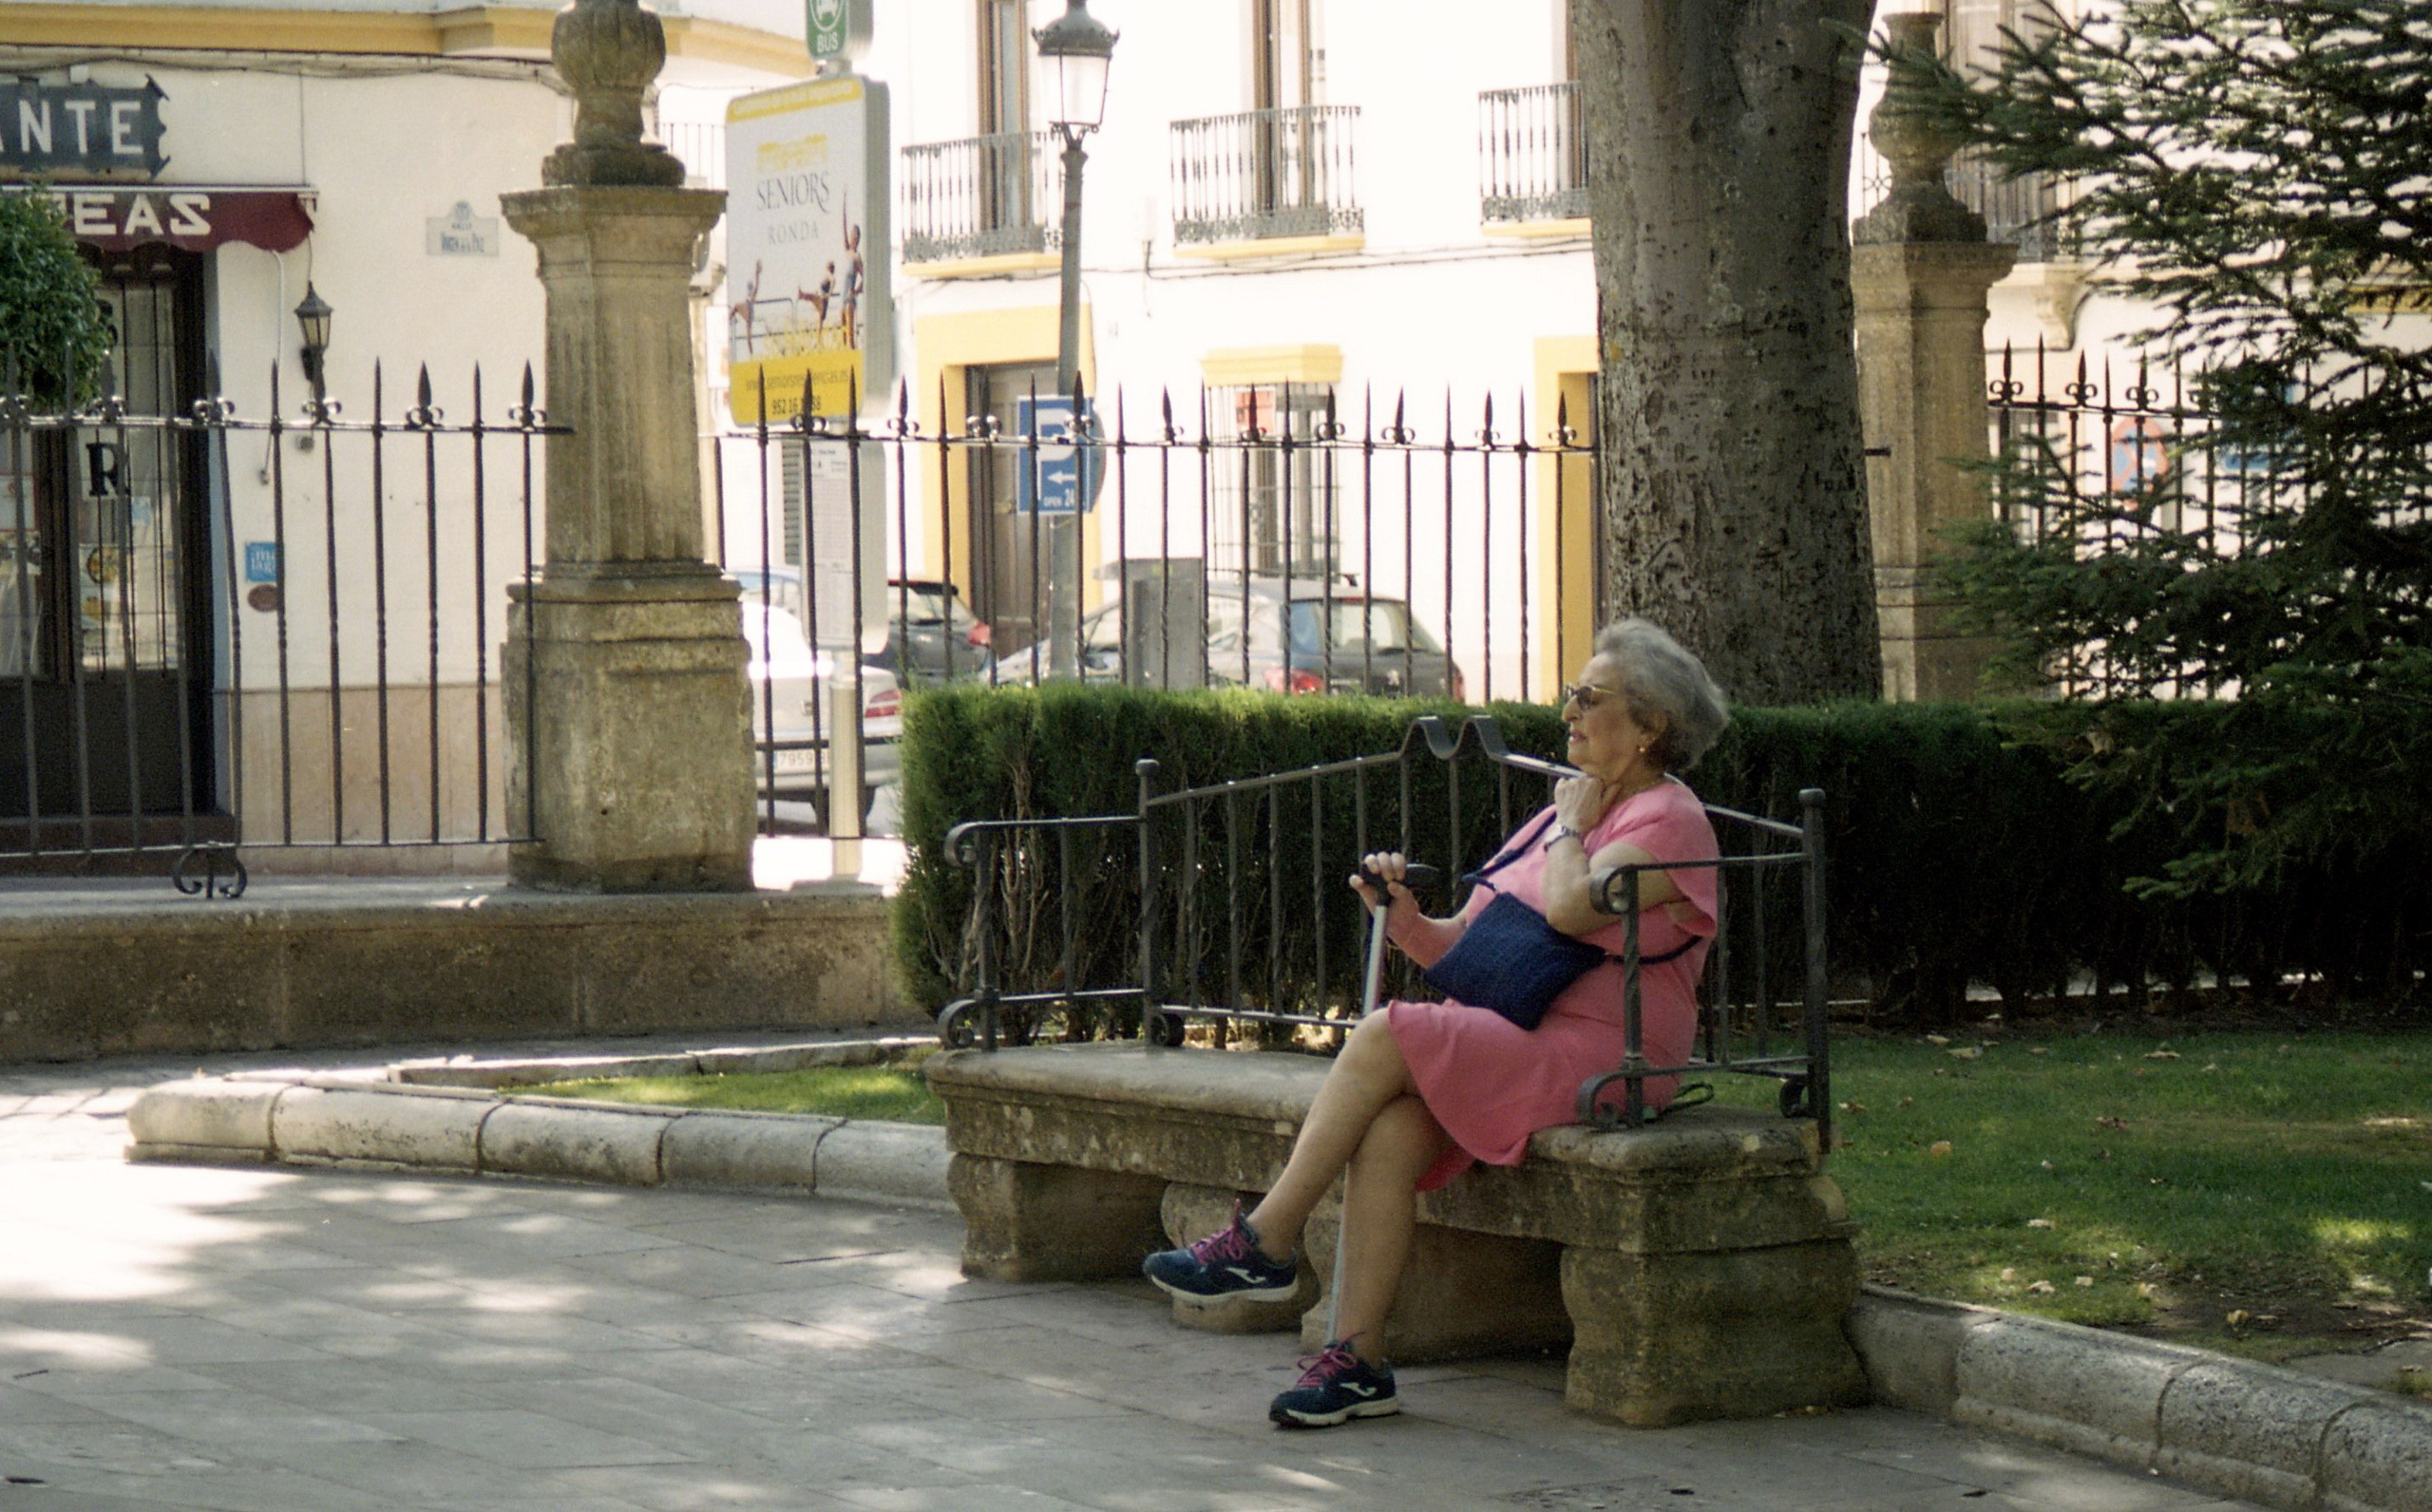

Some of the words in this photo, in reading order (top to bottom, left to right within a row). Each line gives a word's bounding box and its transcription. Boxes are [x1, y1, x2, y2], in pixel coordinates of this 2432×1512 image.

[817, 32, 839, 54] BUS
[0, 99, 142, 155] NTE
[757, 171, 830, 214] SENIORS
[34, 193, 211, 236] EAS
[768, 220, 819, 245] RONDA
[1032, 408, 1076, 501] P
